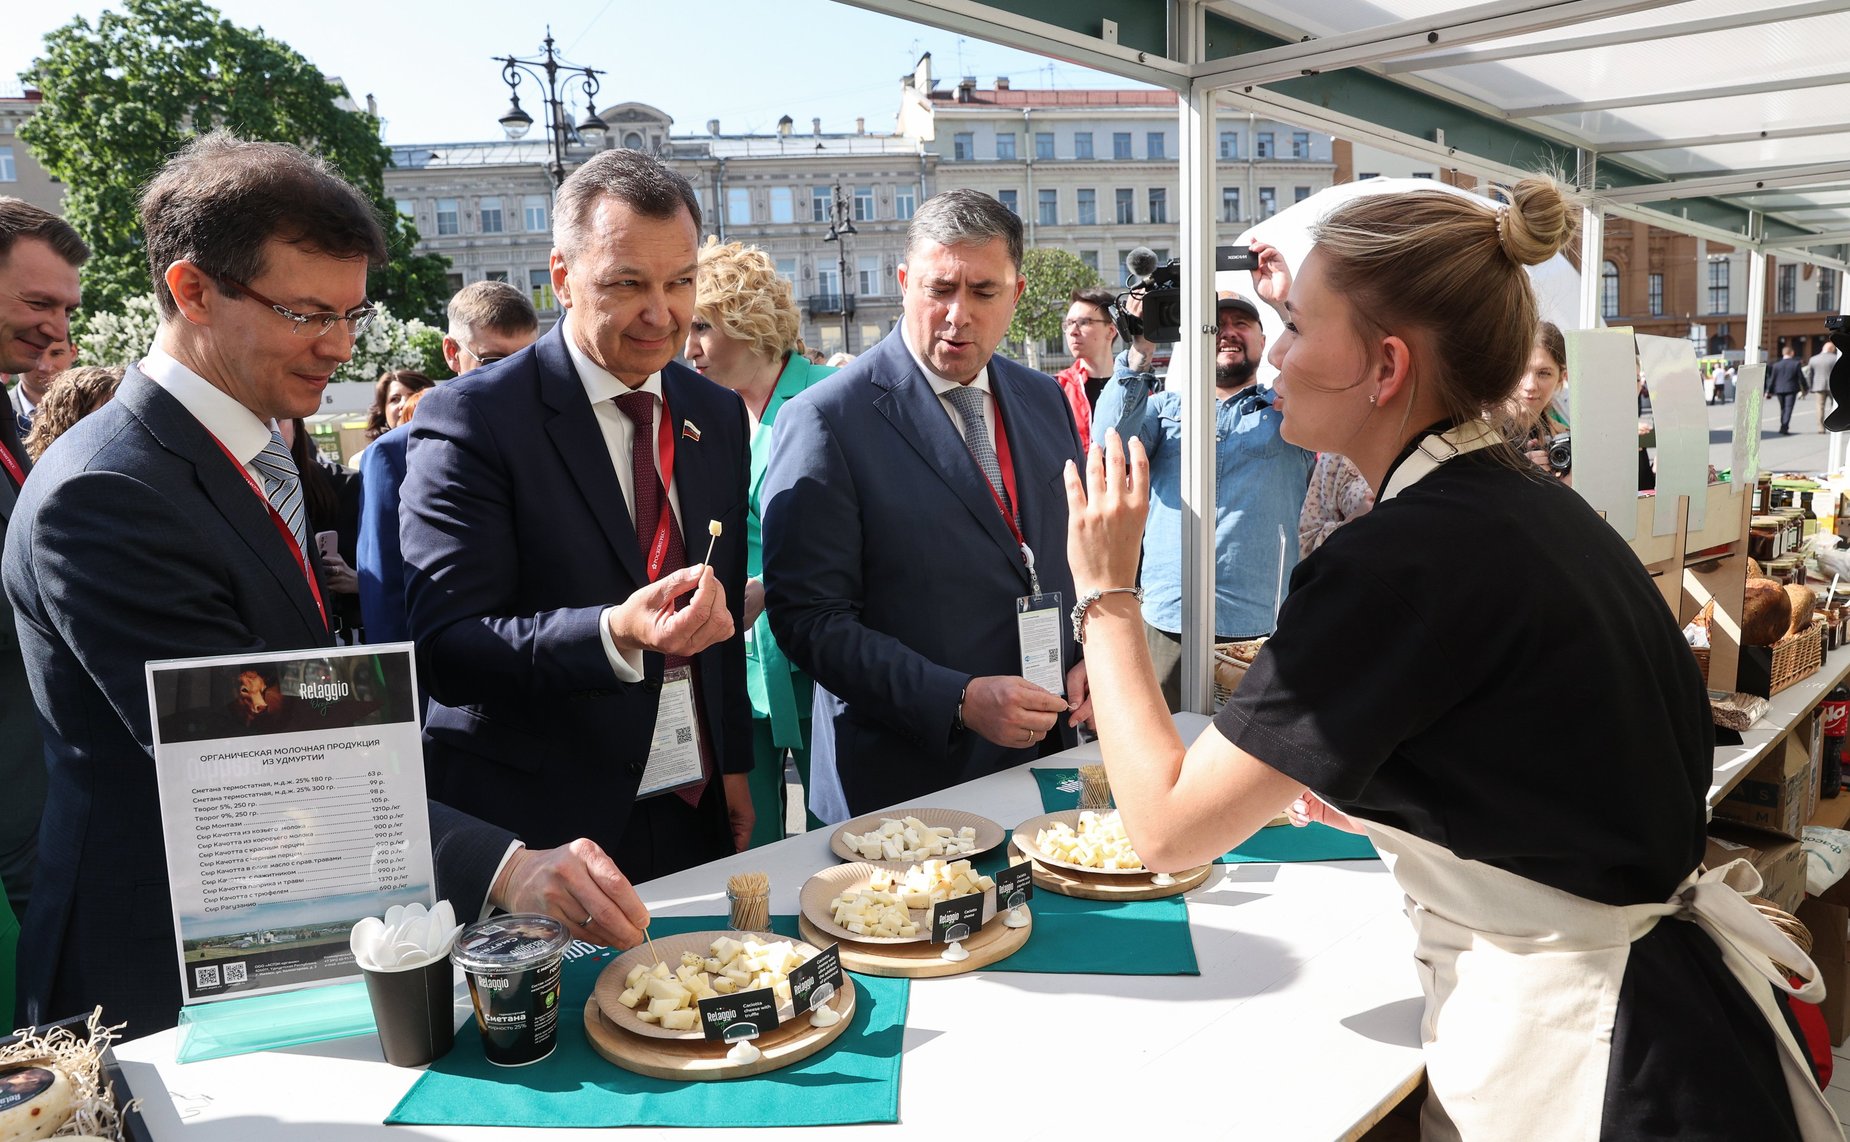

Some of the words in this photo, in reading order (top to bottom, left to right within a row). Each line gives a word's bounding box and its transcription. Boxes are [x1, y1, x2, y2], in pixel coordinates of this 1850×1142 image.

[300, 681, 348, 701] Relaggio
[200, 750, 272, 762] ОРГАНИЧЕСКАЯ
[274, 744, 325, 756] МОЛОЧНАЯ
[327, 740, 380, 750] ПРОДУКЦИЯ
[276, 754, 324, 764] УДМУРТИИ
[192, 786, 221, 794] Сметана
[223, 782, 272, 791] термостатная,
[192, 796, 222, 804] Сметана
[224, 792, 274, 800] термостатная,
[195, 814, 219, 822] Творог
[254, 889, 288, 897] трюфелем
[478, 976, 510, 990] Relaggio
[794, 976, 815, 996] Relaggio
[484, 1014, 526, 1022] Сметана
[707, 1009, 736, 1022] Relaggio
